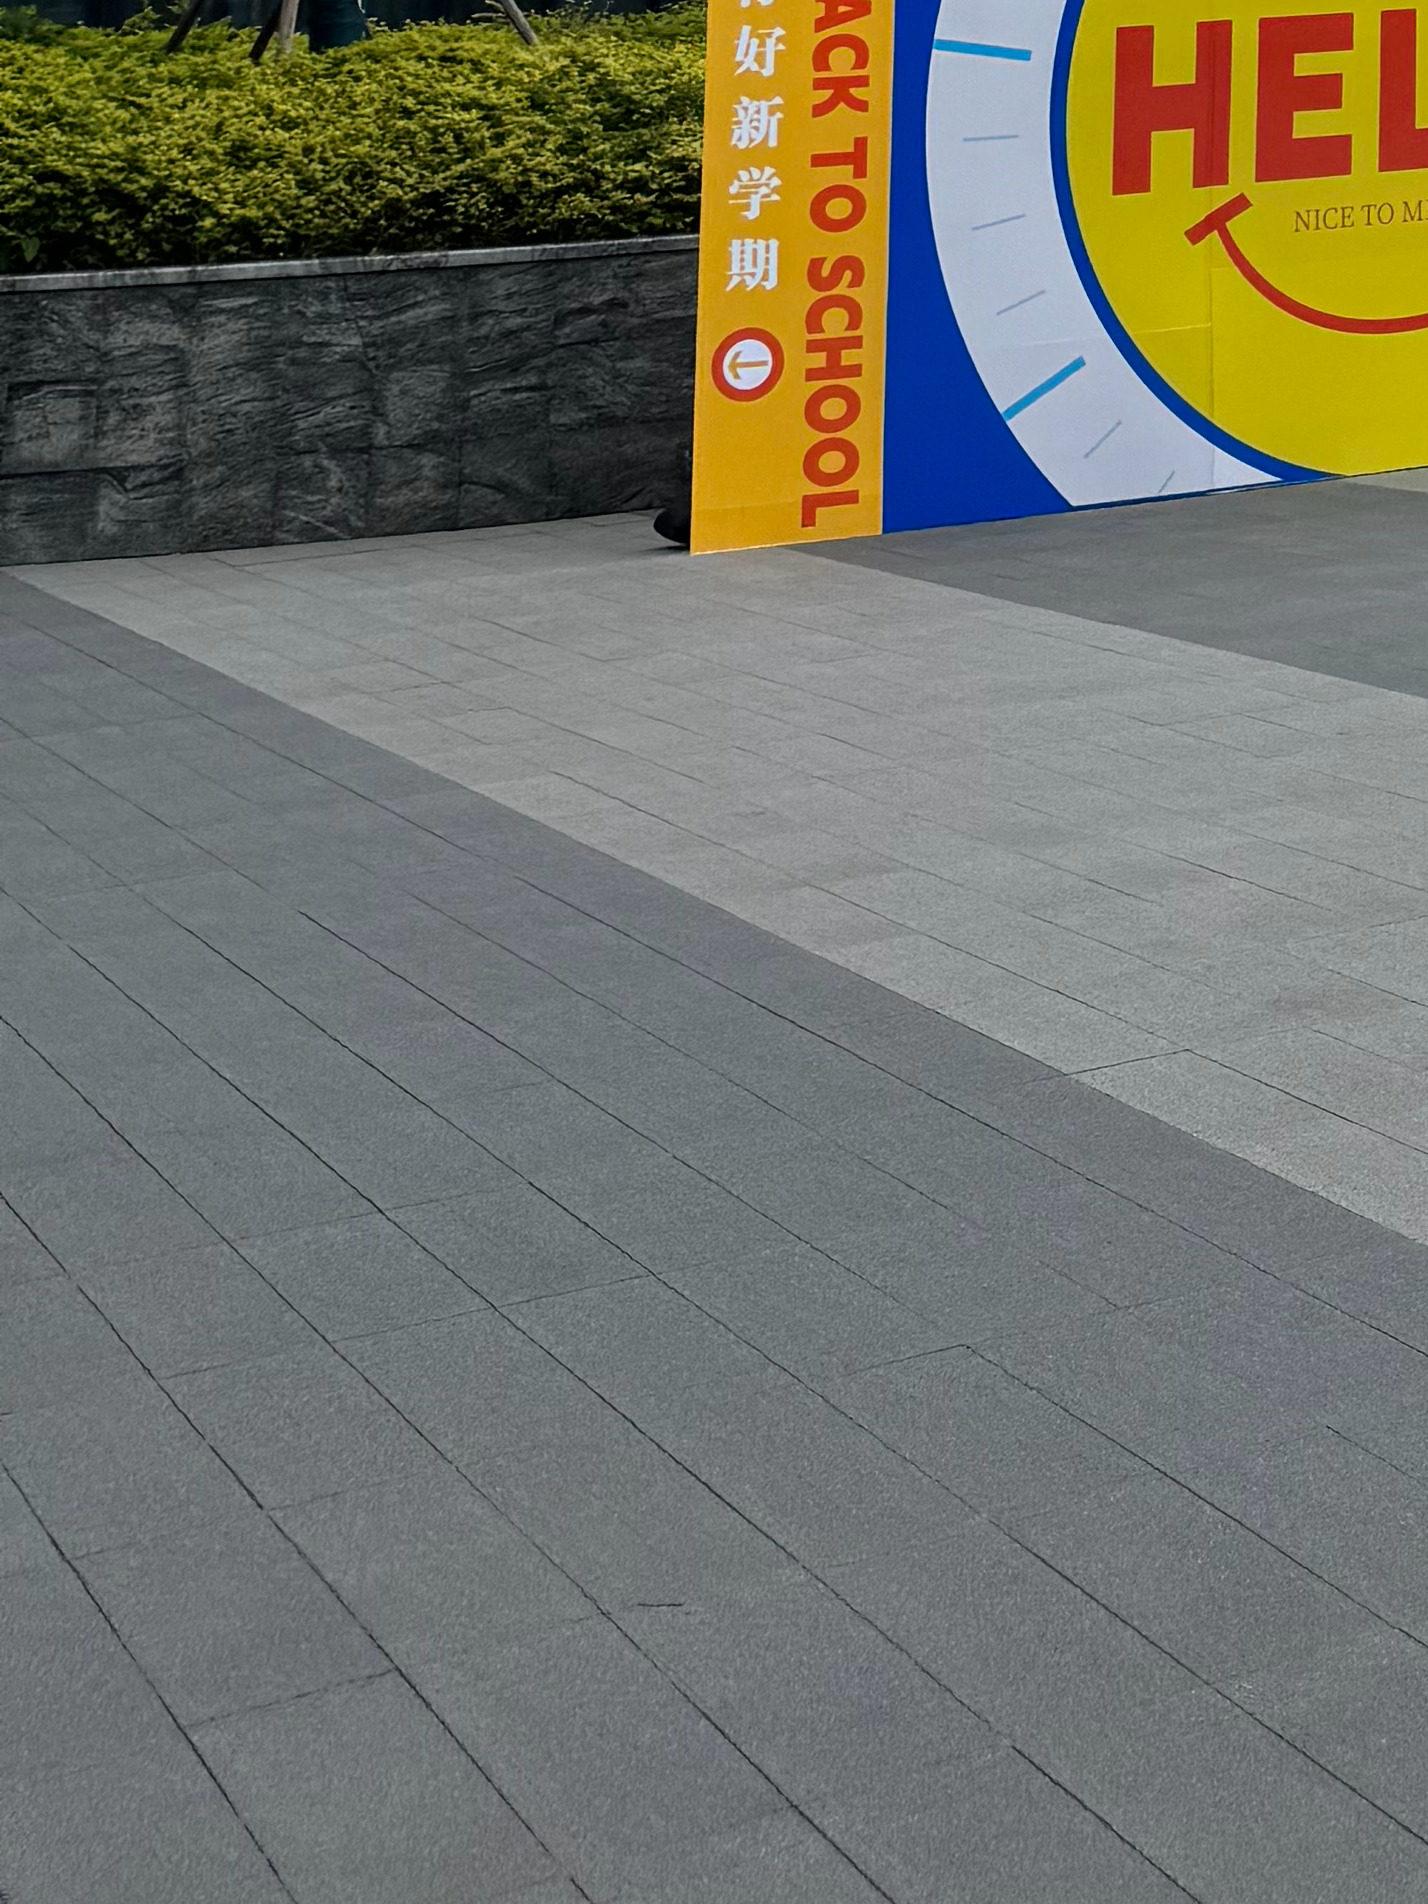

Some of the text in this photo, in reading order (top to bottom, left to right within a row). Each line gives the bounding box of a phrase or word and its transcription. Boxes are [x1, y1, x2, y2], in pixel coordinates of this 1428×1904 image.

[808, 146, 868, 234] TO
[1294, 205, 1354, 233] NICE
[1361, 202, 1395, 227] TO
[801, 255, 865, 529] SCHOOL
